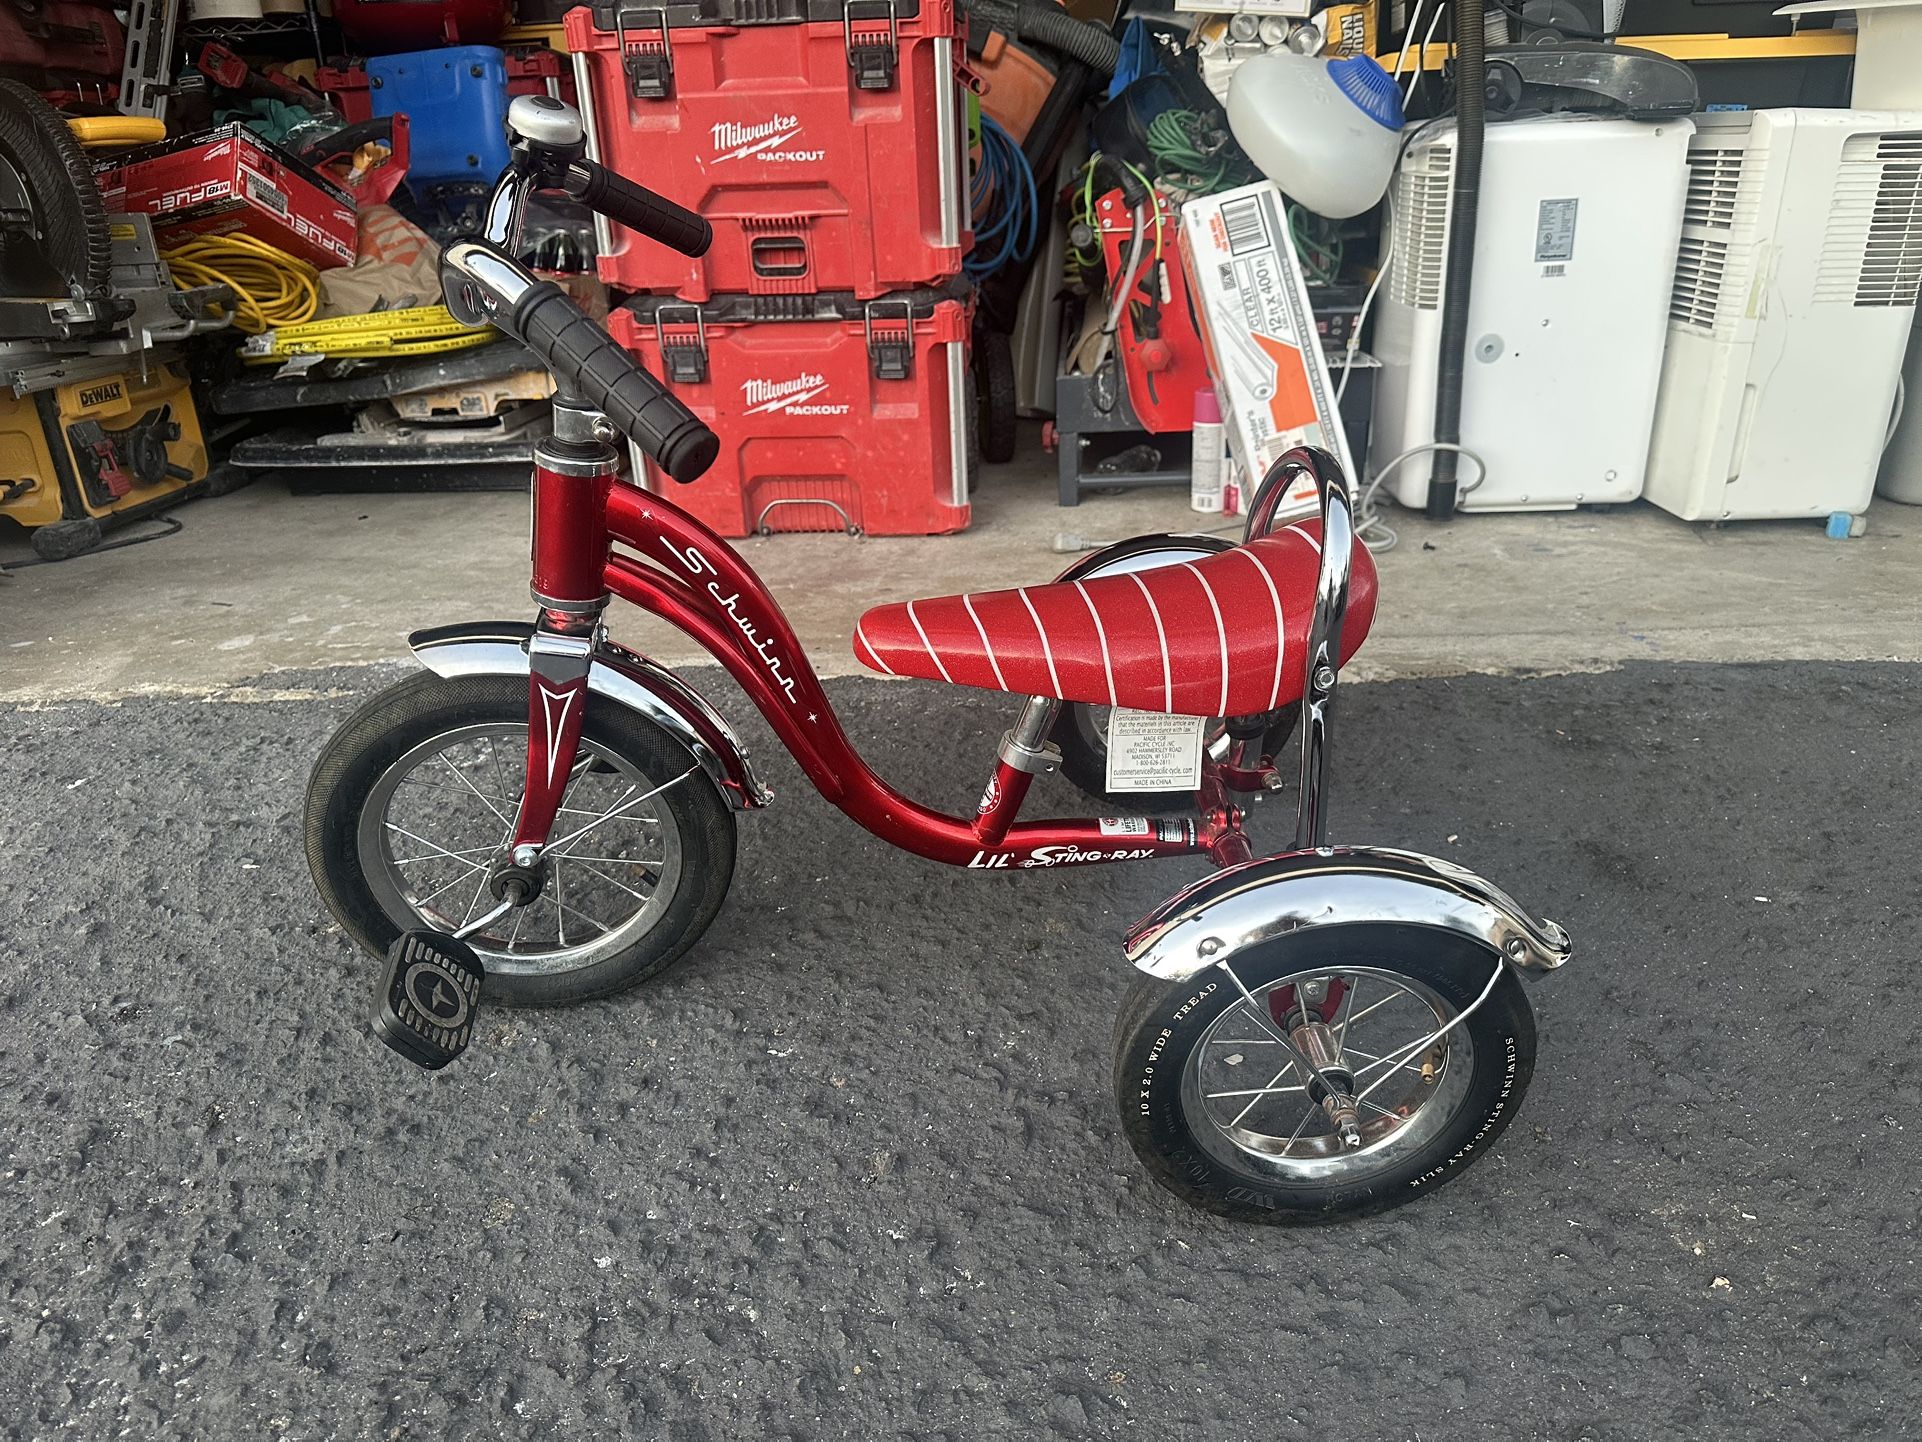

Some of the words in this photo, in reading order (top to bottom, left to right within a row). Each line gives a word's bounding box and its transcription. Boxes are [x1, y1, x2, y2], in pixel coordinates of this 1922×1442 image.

[1336, 16, 1353, 56] NAILS
[708, 113, 798, 150] Milwaukee
[757, 151, 825, 162] PACKOUT
[148, 187, 205, 210] FUEL
[207, 183, 229, 195] M18
[287, 213, 335, 250] FUEL
[1256, 268, 1273, 294] 400
[1242, 287, 1260, 327] CLEAR
[1268, 316, 1283, 333] 12
[740, 371, 825, 406] Milwaukee
[785, 405, 849, 415] PACKOUT
[659, 535, 797, 704] Schwinn
[967, 850, 1015, 869] LIL'
[1173, 982, 1218, 1021] TREAD
[1148, 1028, 1172, 1062] WIDE
[1142, 1067, 1154, 1086] 2.0
[1501, 1037, 1516, 1098] SCHWINN
[1140, 1090, 1150, 1098] X
[1140, 1103, 1150, 1116] 10
[1448, 1102, 1504, 1166] STING-RAY
[1410, 1166, 1444, 1188] SLIK
